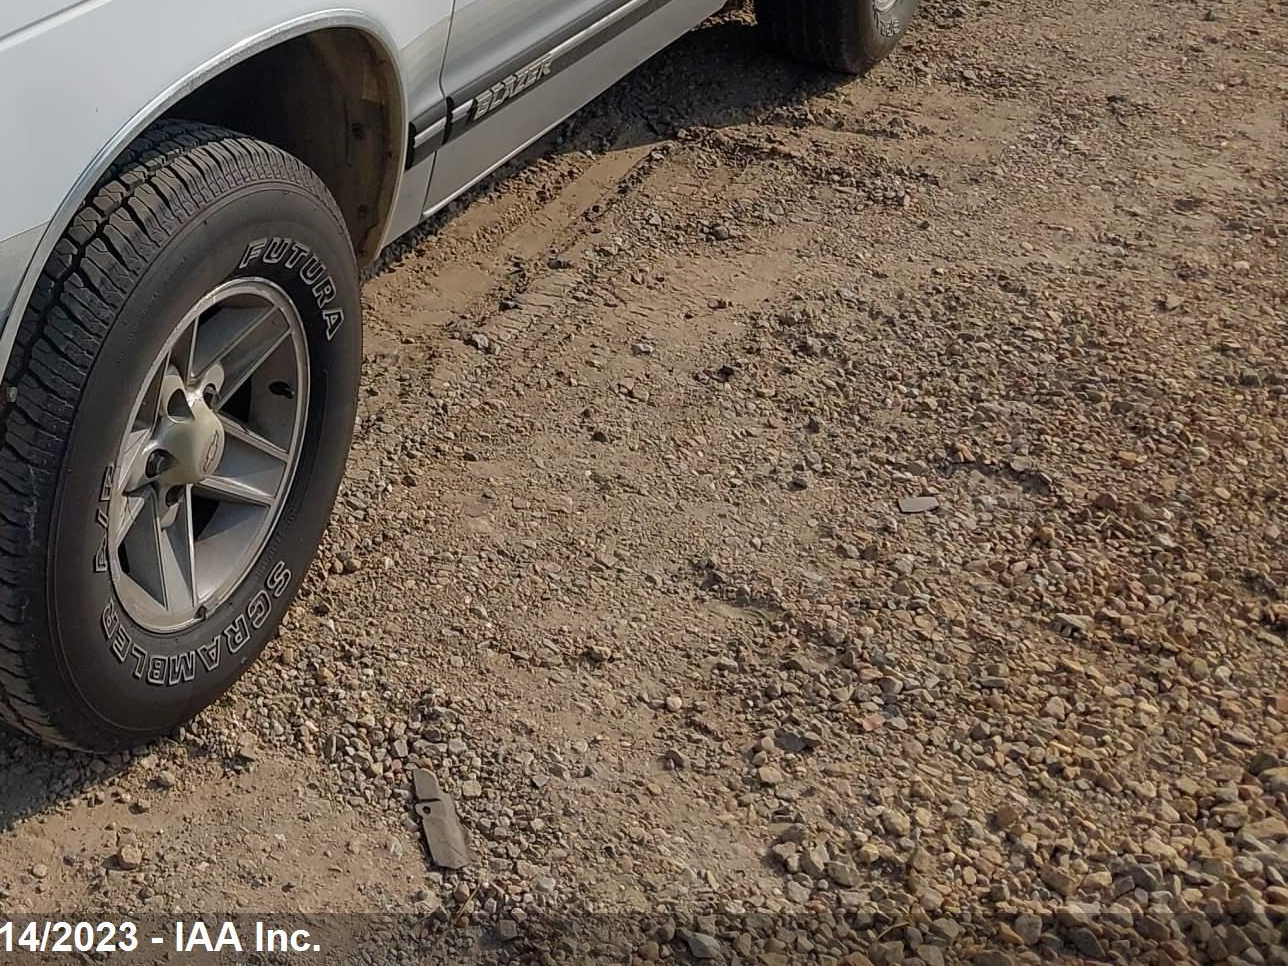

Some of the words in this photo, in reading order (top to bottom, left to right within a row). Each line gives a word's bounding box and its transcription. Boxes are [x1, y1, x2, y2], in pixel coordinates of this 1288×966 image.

[473, 53, 553, 121] BLAZER
[239, 237, 345, 341] FUTURA
[103, 560, 292, 686] SCRAMBLER
